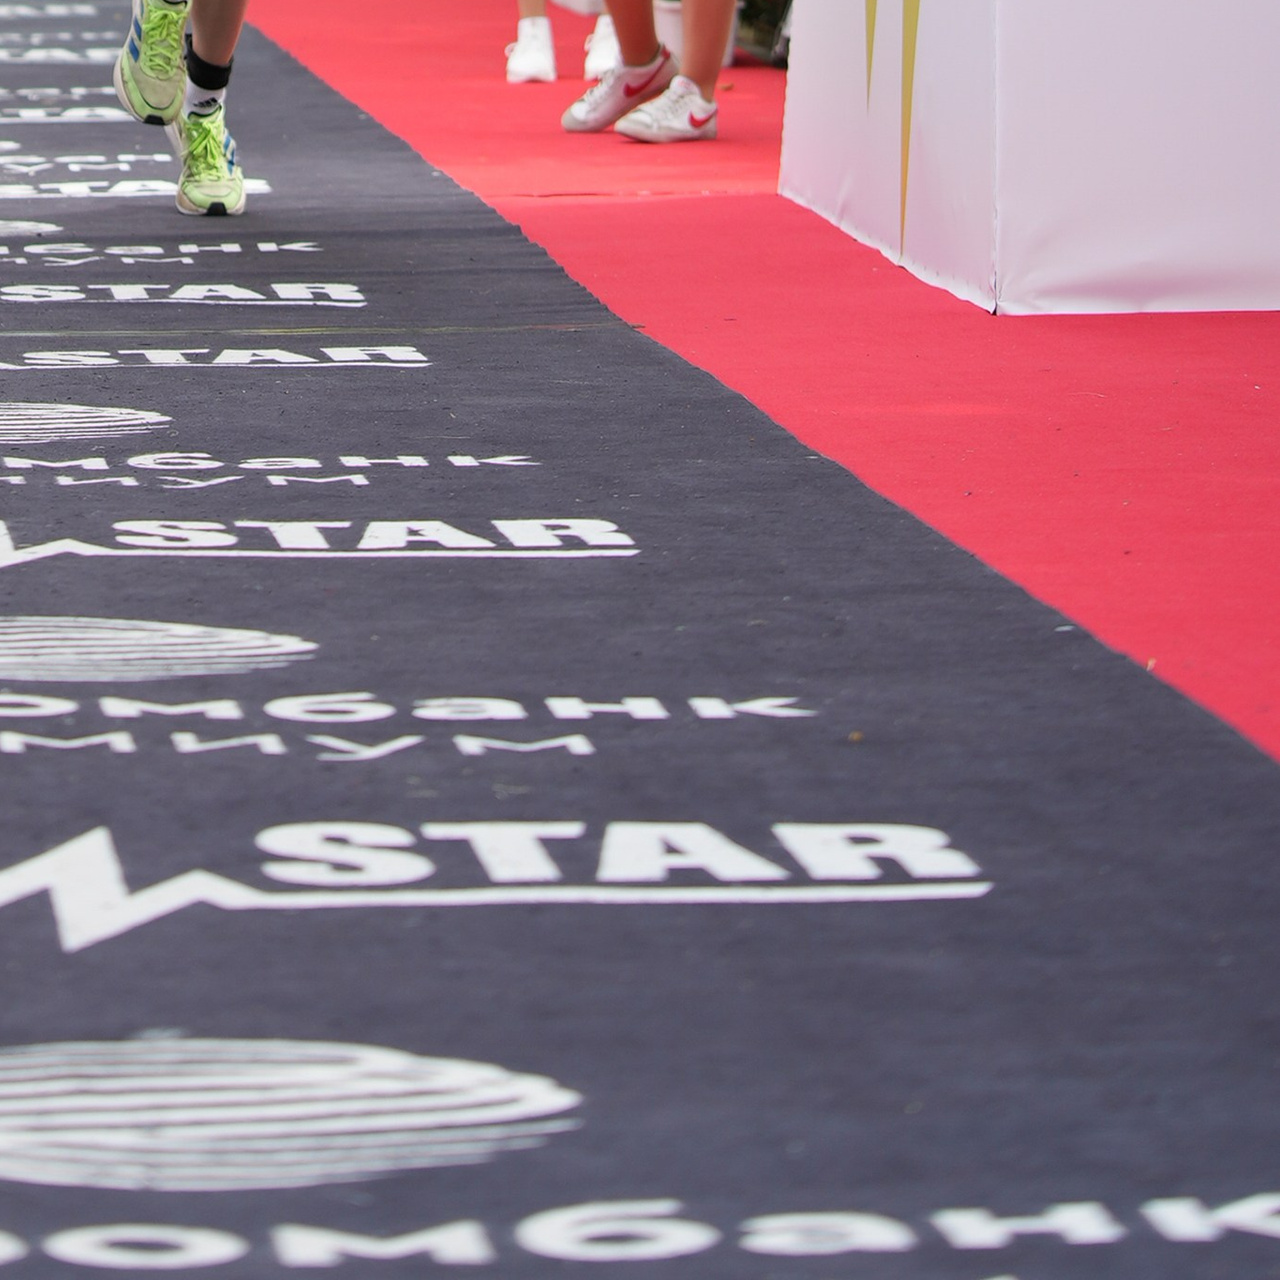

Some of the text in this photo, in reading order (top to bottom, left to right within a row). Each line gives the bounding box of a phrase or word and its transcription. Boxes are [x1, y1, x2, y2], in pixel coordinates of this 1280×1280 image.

[0, 283, 365, 301] STAR
[21, 345, 432, 365] STAR
[111, 519, 636, 548] STAR
[255, 821, 983, 886] STAR
